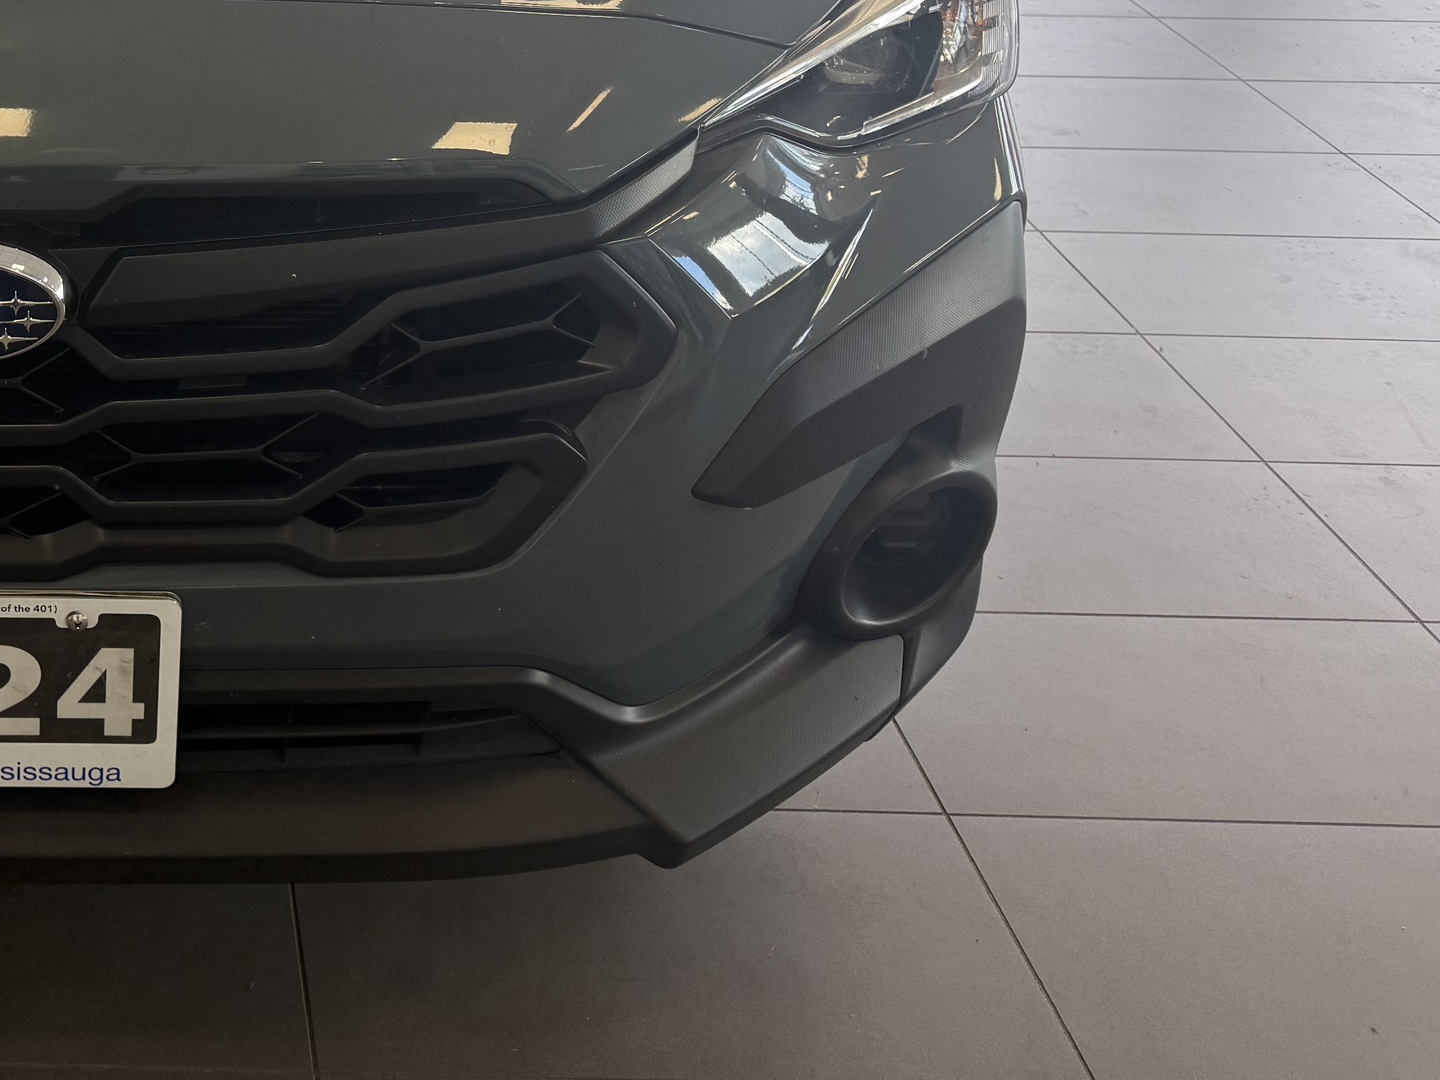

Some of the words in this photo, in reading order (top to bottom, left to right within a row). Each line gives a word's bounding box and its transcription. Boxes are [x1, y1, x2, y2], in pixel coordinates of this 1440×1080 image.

[0, 604, 12, 613] of
[14, 604, 31, 613] the
[33, 604, 58, 614] 401)
